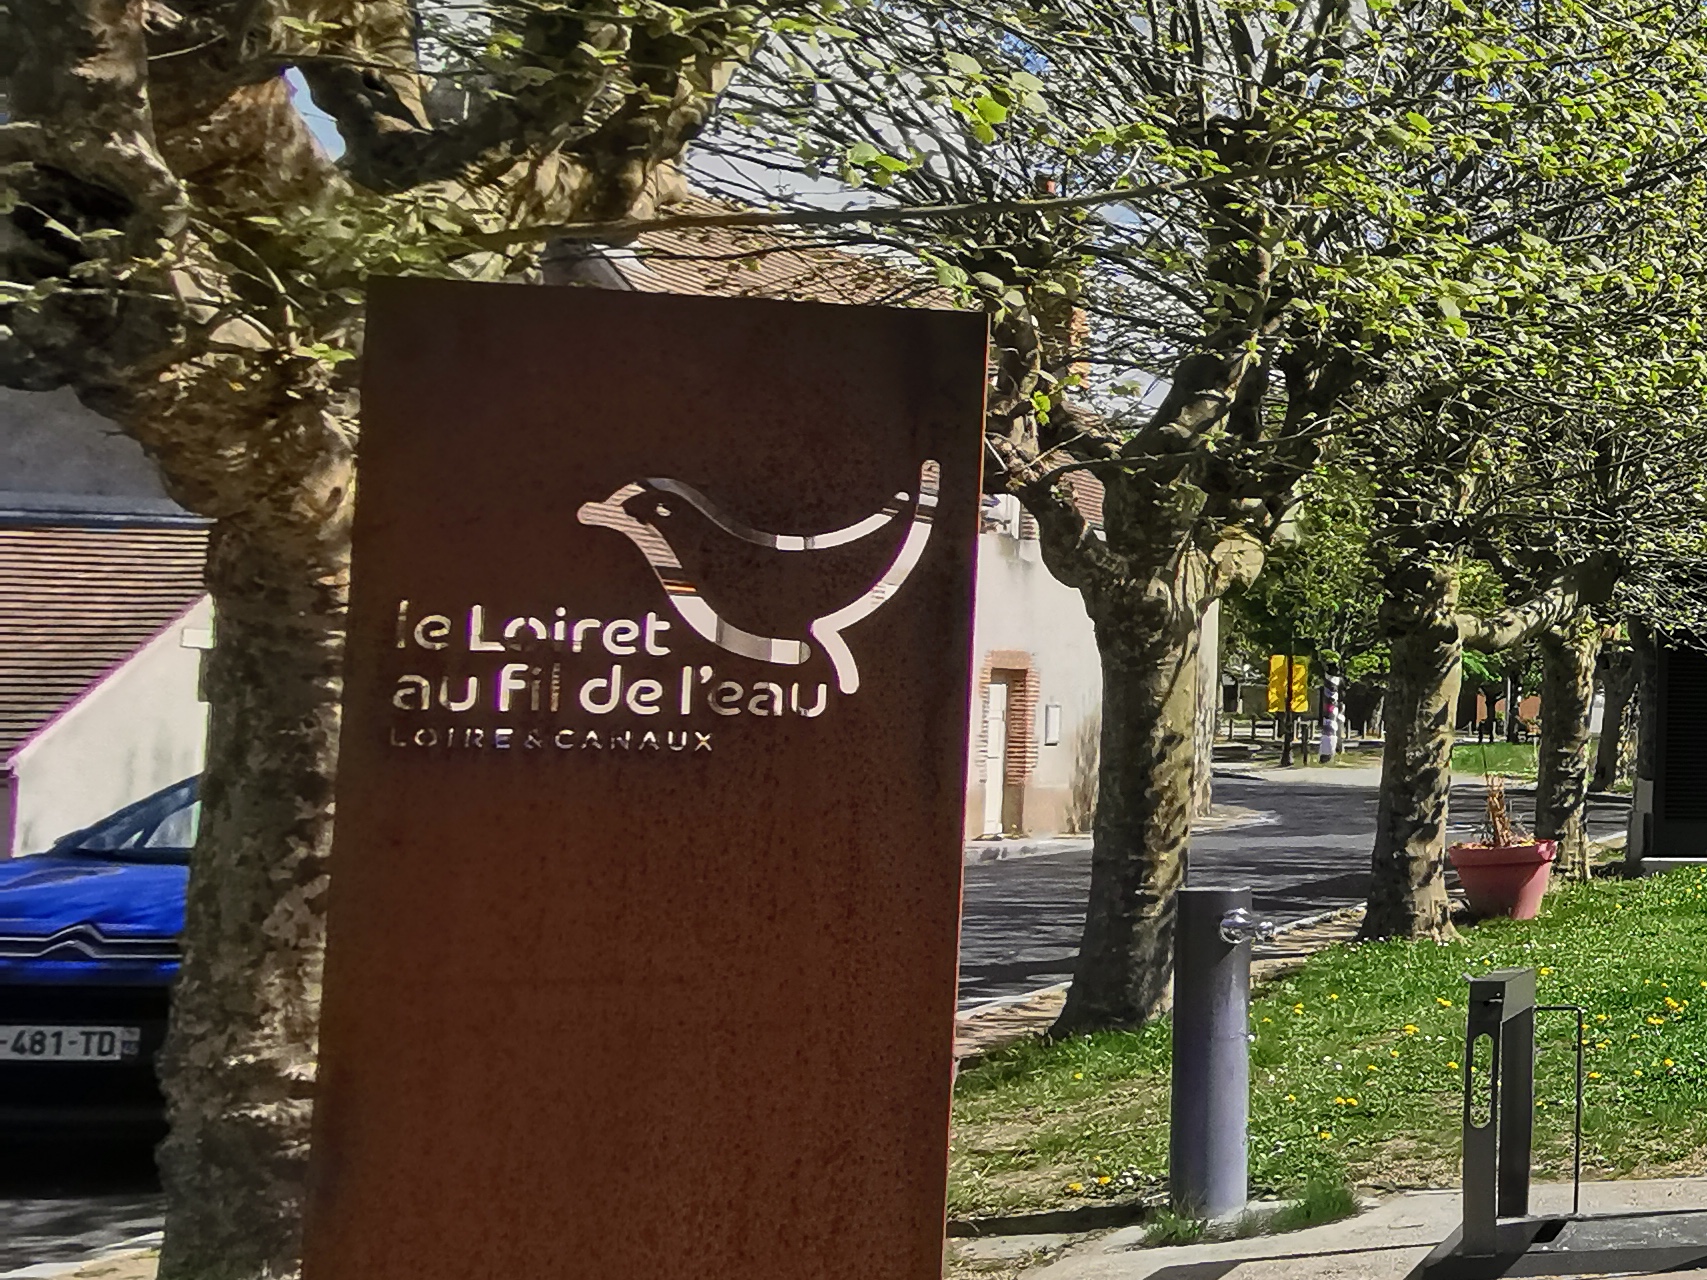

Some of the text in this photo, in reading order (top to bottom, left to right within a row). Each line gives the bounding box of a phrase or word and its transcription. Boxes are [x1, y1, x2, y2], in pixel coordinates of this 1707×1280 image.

[395, 597, 672, 657] le Loiret
[391, 662, 829, 718] au fil de l'eau
